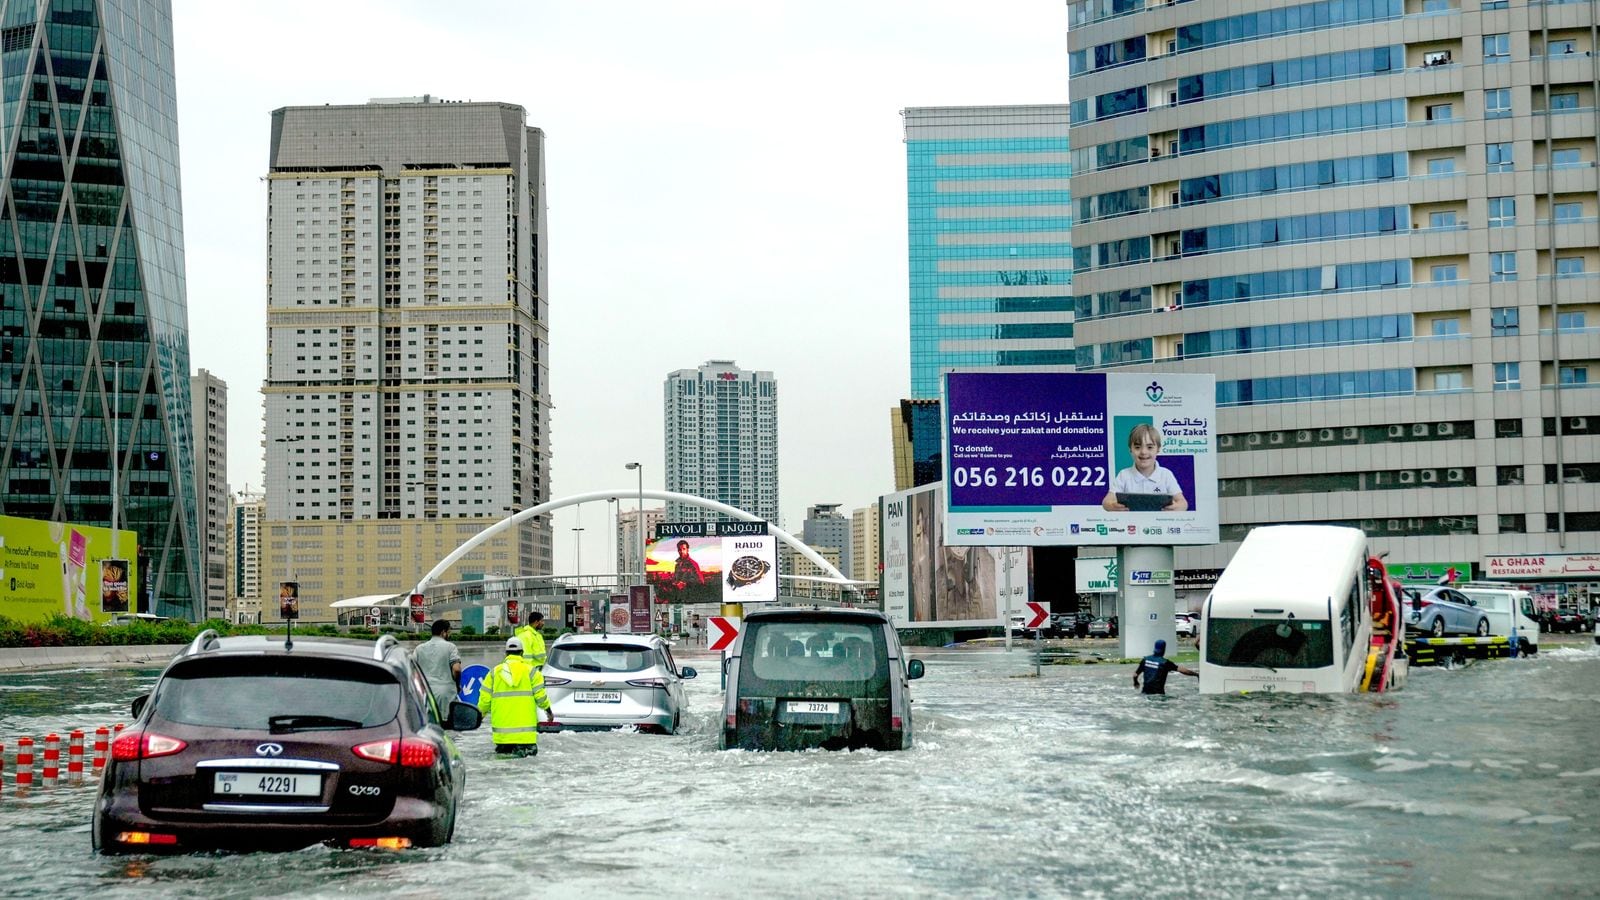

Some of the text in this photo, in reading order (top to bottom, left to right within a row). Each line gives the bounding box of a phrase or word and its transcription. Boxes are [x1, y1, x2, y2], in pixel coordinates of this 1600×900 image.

[953, 411, 1103, 425] نستقبل زكاتكم وصدقاتكم
[1163, 417, 1207, 428] زكاتكم
[1183, 428, 1207, 436] Zakat
[1178, 438, 1208, 447] تصنع
[954, 466, 1106, 487] 056 216 0222
[888, 501, 903, 520] PAN
[661, 525, 702, 533] RIVOLI
[1491, 558, 1545, 566] AL GHAAR
[1088, 580, 1111, 588] UMAI
[224, 783, 231, 792] D
[258, 777, 296, 792] 42291
[349, 785, 380, 796] QX50
